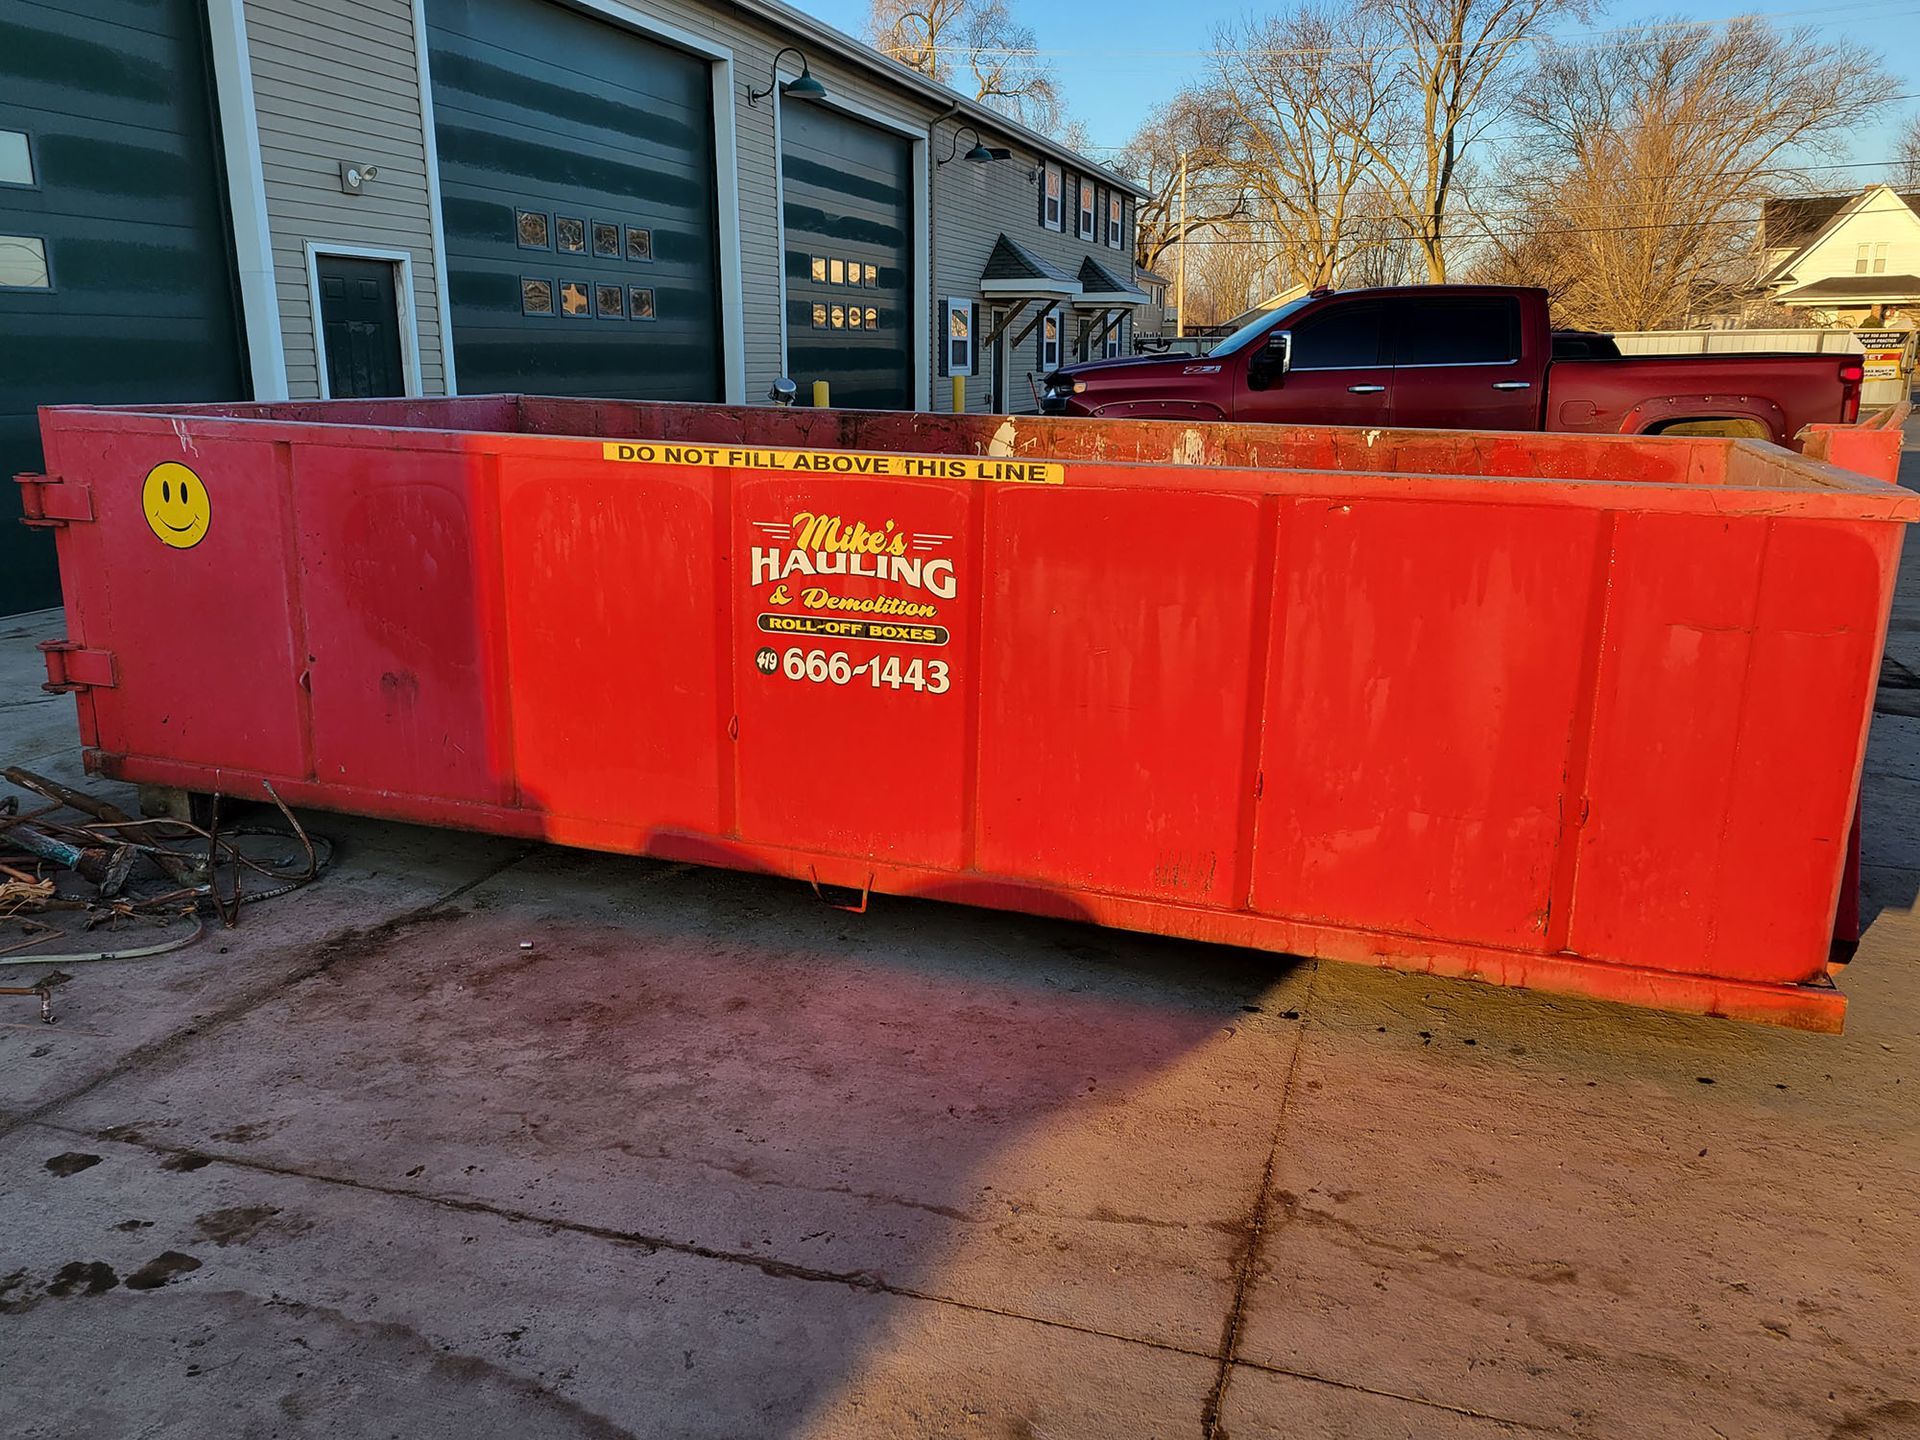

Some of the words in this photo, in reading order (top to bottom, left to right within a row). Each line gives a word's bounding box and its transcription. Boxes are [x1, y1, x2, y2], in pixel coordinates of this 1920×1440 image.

[618, 445, 655, 461] DO
[665, 447, 719, 465] NOT
[728, 451, 784, 468] FILL
[793, 454, 889, 474] ABOVE
[904, 459, 966, 477] THIS
[977, 462, 1046, 482] LINE
[792, 512, 908, 556] Mike's
[751, 546, 957, 599] HAULING
[769, 584, 793, 606] &
[800, 587, 937, 618] Demolition
[769, 617, 862, 635] ROLL-OFF
[869, 625, 936, 641] BOXES
[756, 651, 778, 671] 419
[783, 647, 950, 694] 666-1443
